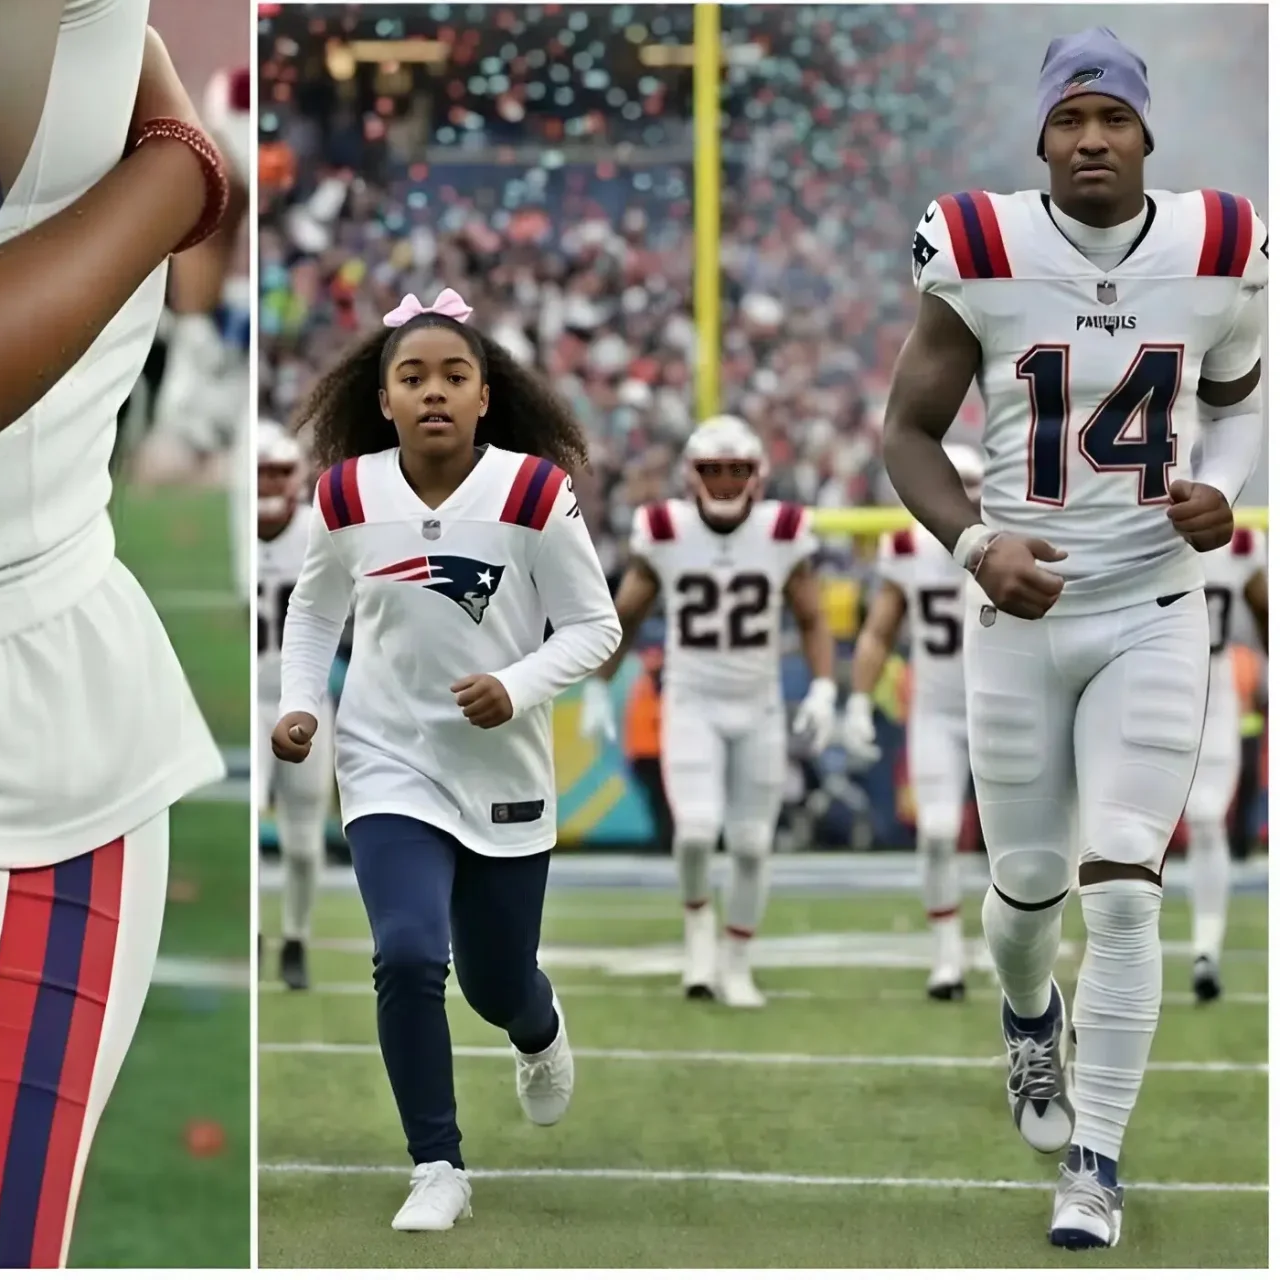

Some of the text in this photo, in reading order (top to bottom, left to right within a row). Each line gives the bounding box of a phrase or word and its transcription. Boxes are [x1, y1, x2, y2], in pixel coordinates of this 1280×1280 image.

[1016, 343, 1185, 507] 14
[677, 572, 771, 648] 22
[917, 587, 963, 658] 5
